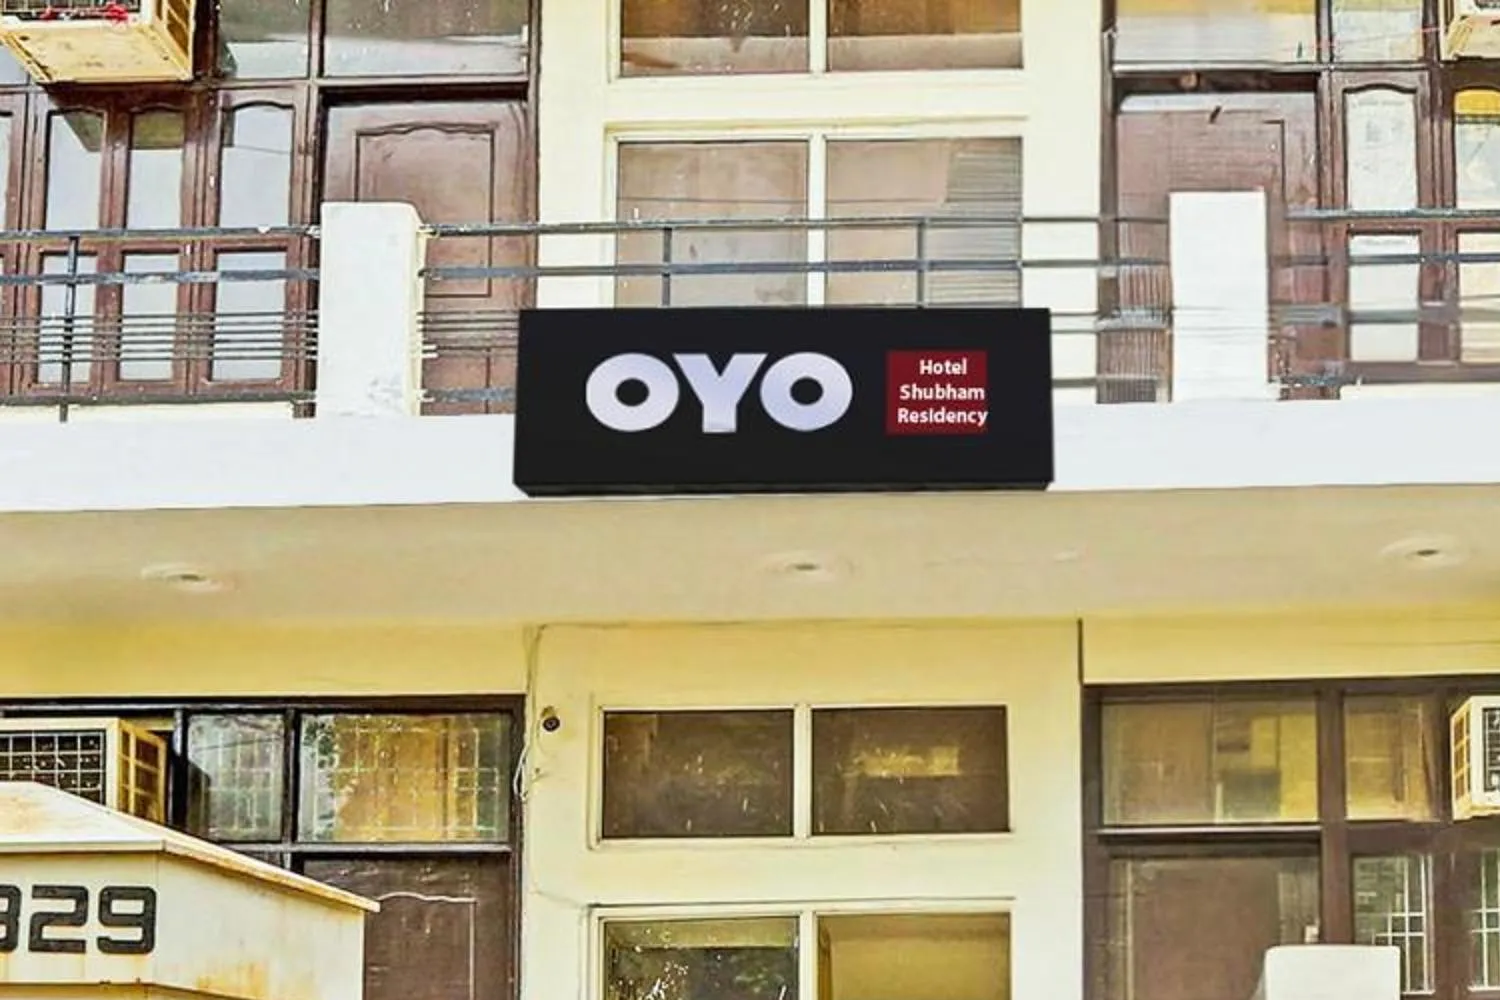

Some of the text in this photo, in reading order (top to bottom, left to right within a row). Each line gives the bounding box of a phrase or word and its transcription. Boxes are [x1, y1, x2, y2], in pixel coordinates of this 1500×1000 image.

[919, 358, 967, 375] Hotel
[586, 352, 853, 433] OYO
[899, 383, 985, 400] Shubham
[897, 407, 988, 427] Residency
